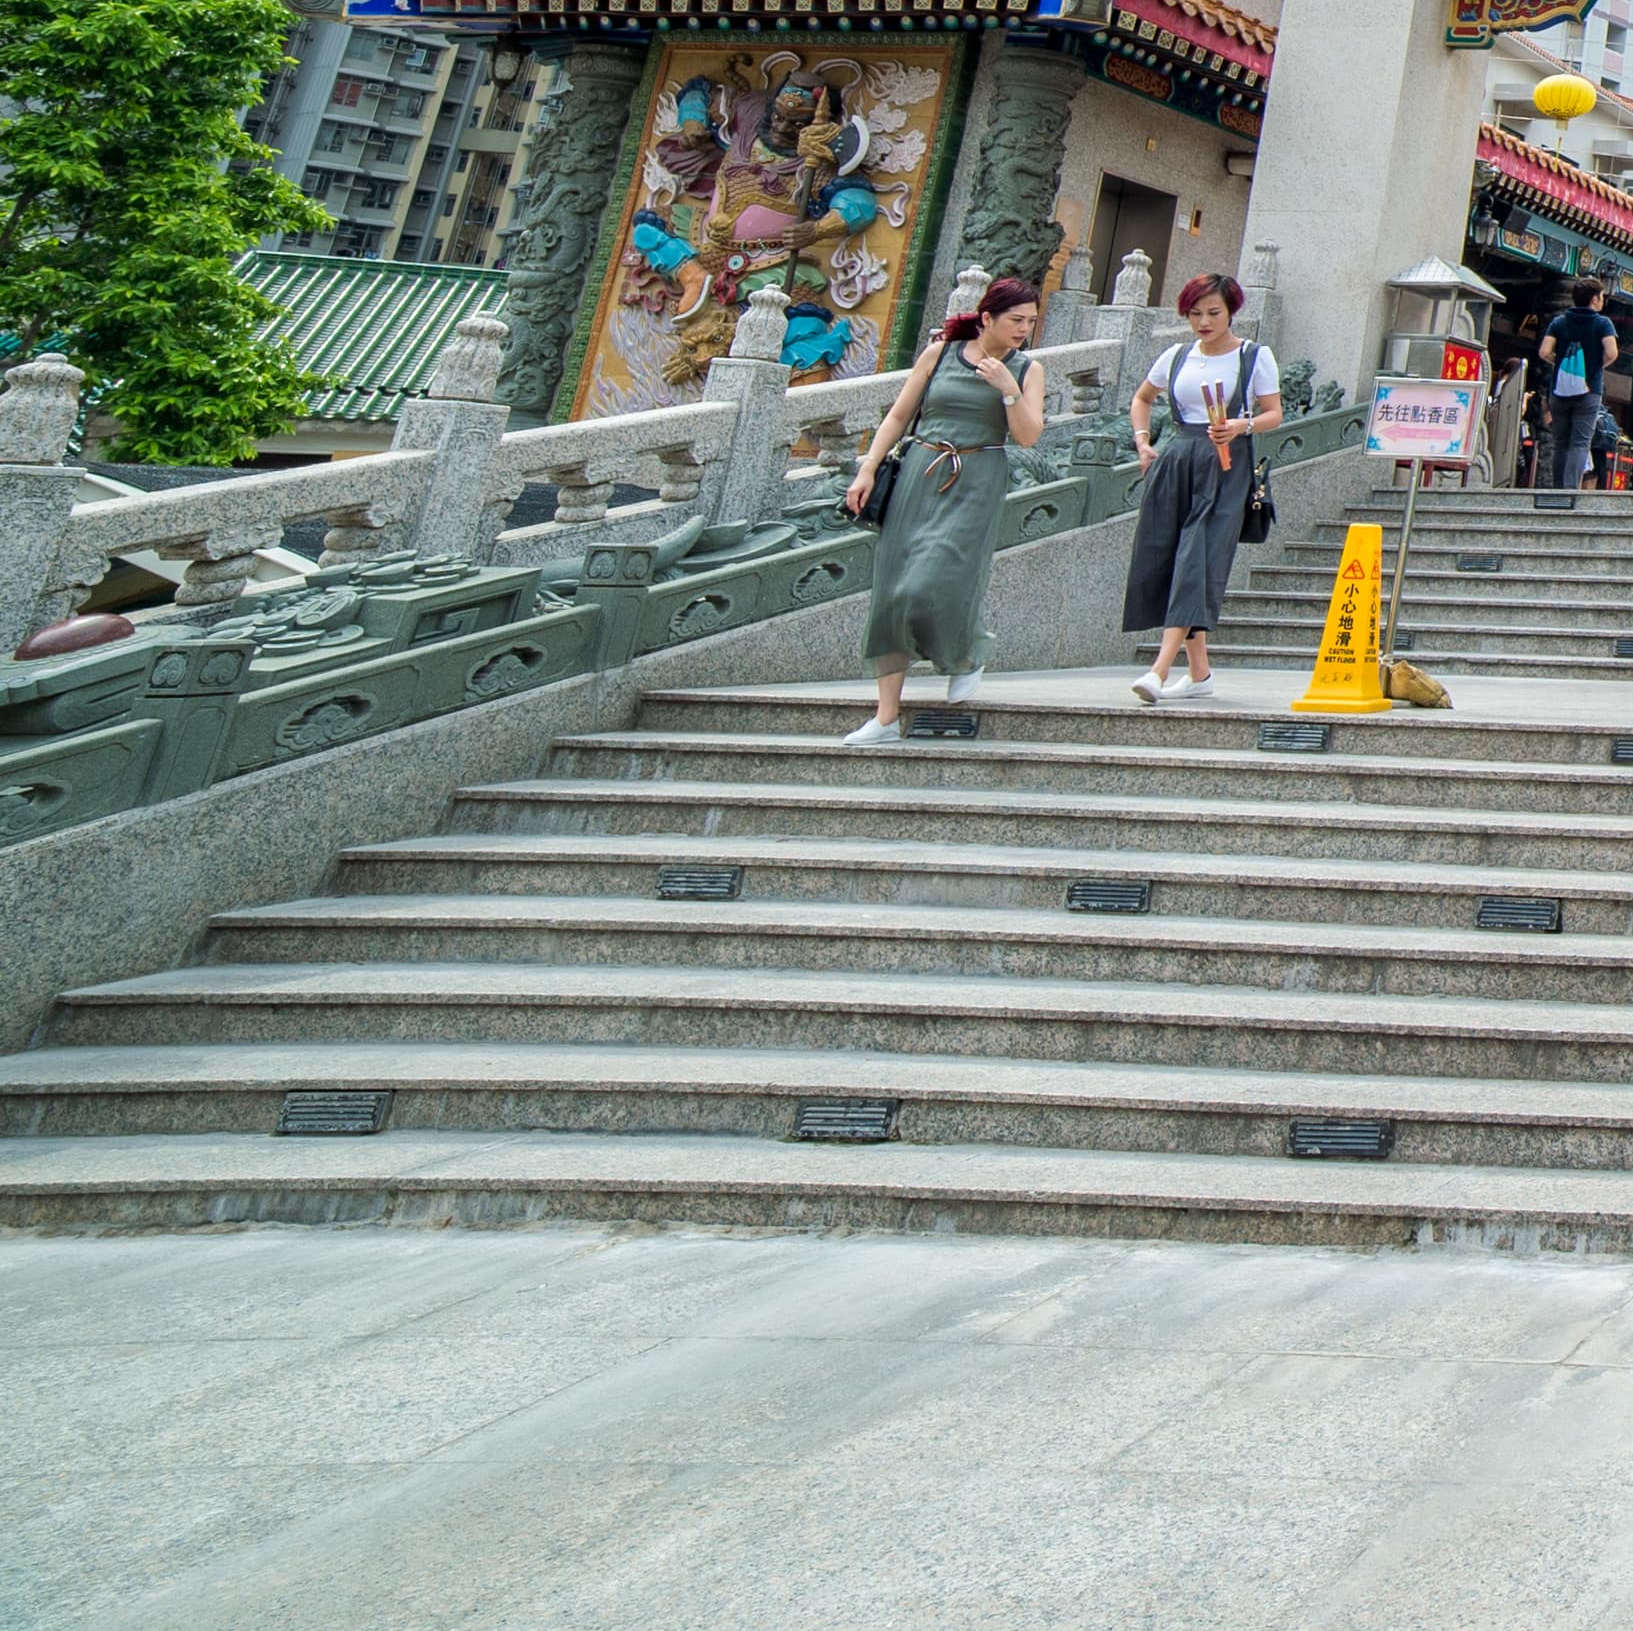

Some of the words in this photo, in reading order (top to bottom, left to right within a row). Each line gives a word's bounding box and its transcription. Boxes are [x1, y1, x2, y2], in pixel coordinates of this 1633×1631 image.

[1377, 404, 1459, 425] 先往點香區
[1335, 583, 1360, 647] 小心地滑
